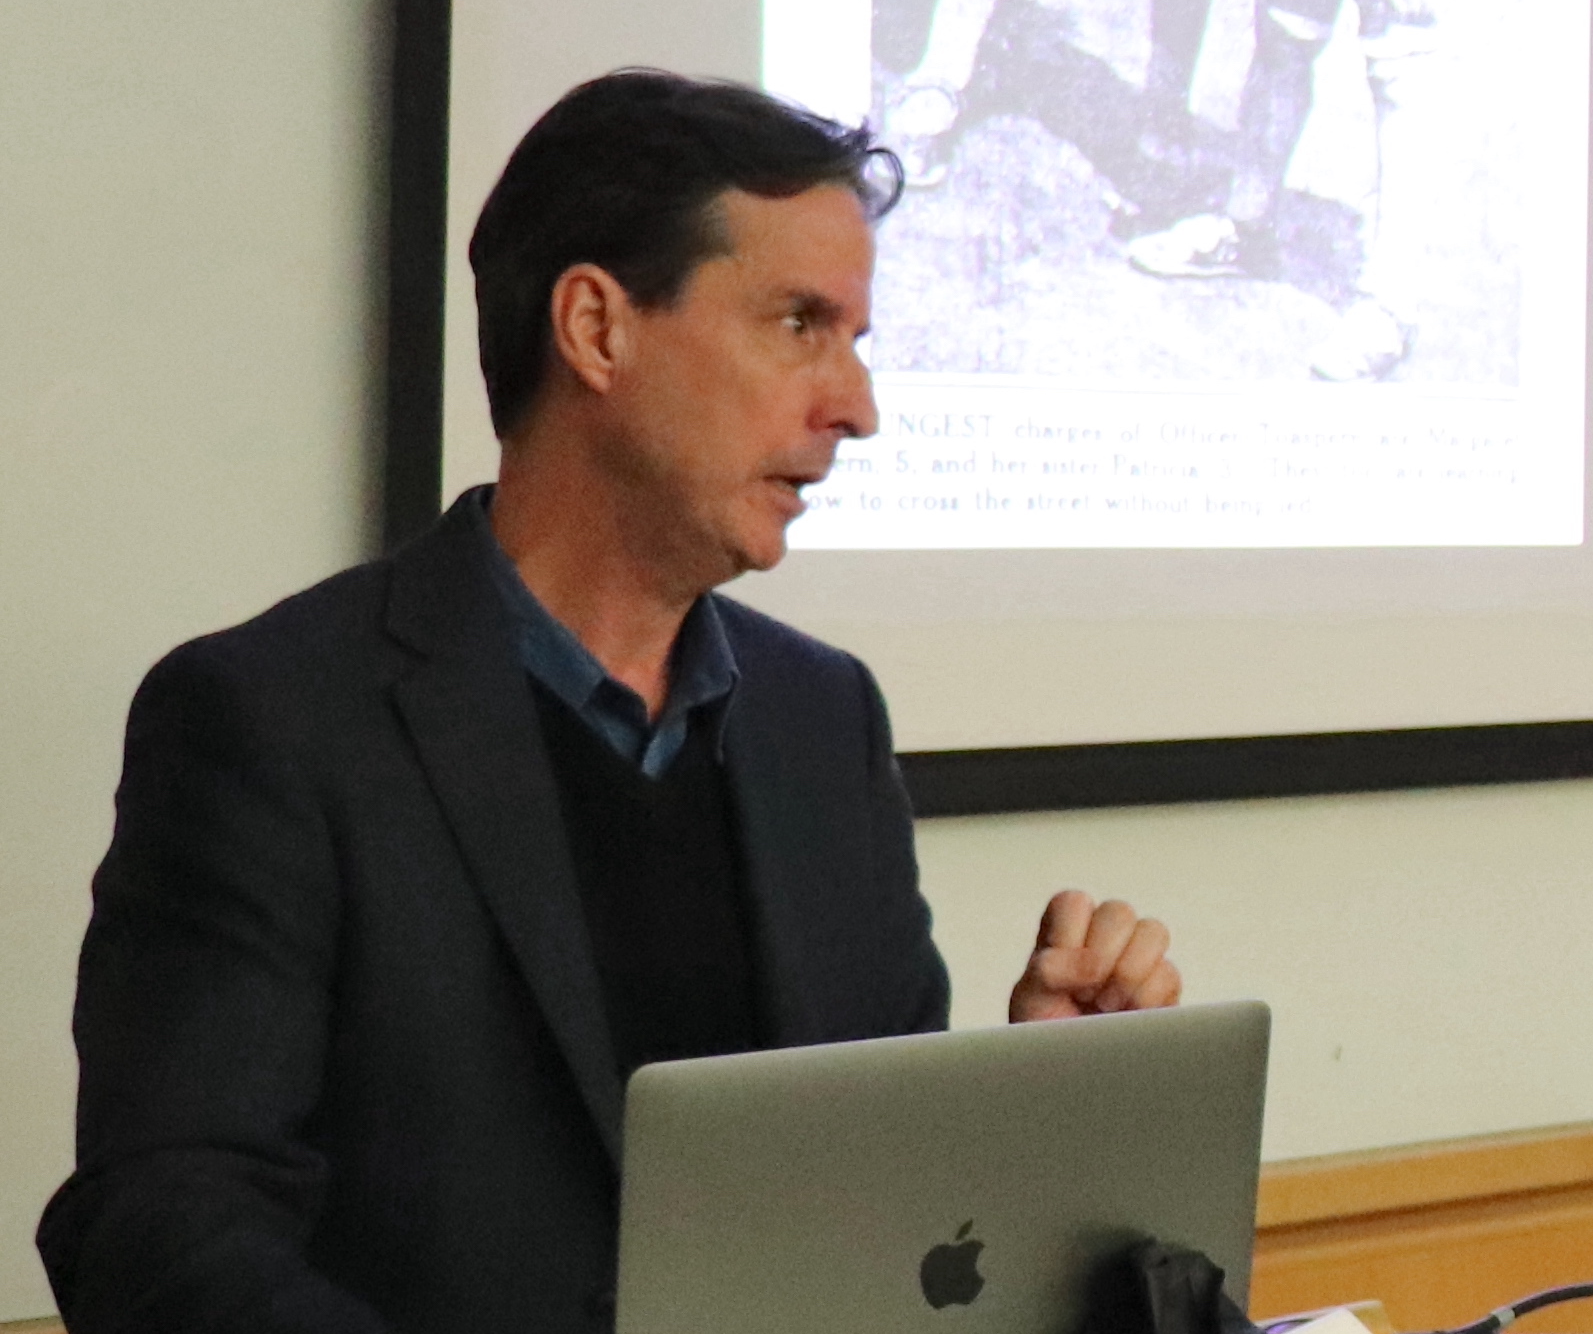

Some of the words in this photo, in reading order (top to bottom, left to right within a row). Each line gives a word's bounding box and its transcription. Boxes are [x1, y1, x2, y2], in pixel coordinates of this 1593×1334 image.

[878, 412, 995, 438] UNGEST
[834, 457, 879, 475] ern,
[931, 450, 977, 475] and
[991, 450, 1028, 475] her
[1042, 458, 1099, 476] sister
[806, 494, 843, 512] ow
[859, 491, 883, 512] to
[898, 494, 961, 512] cross
[975, 487, 1013, 512] the
[1026, 492, 1090, 512] street
[1104, 490, 1190, 514] without
